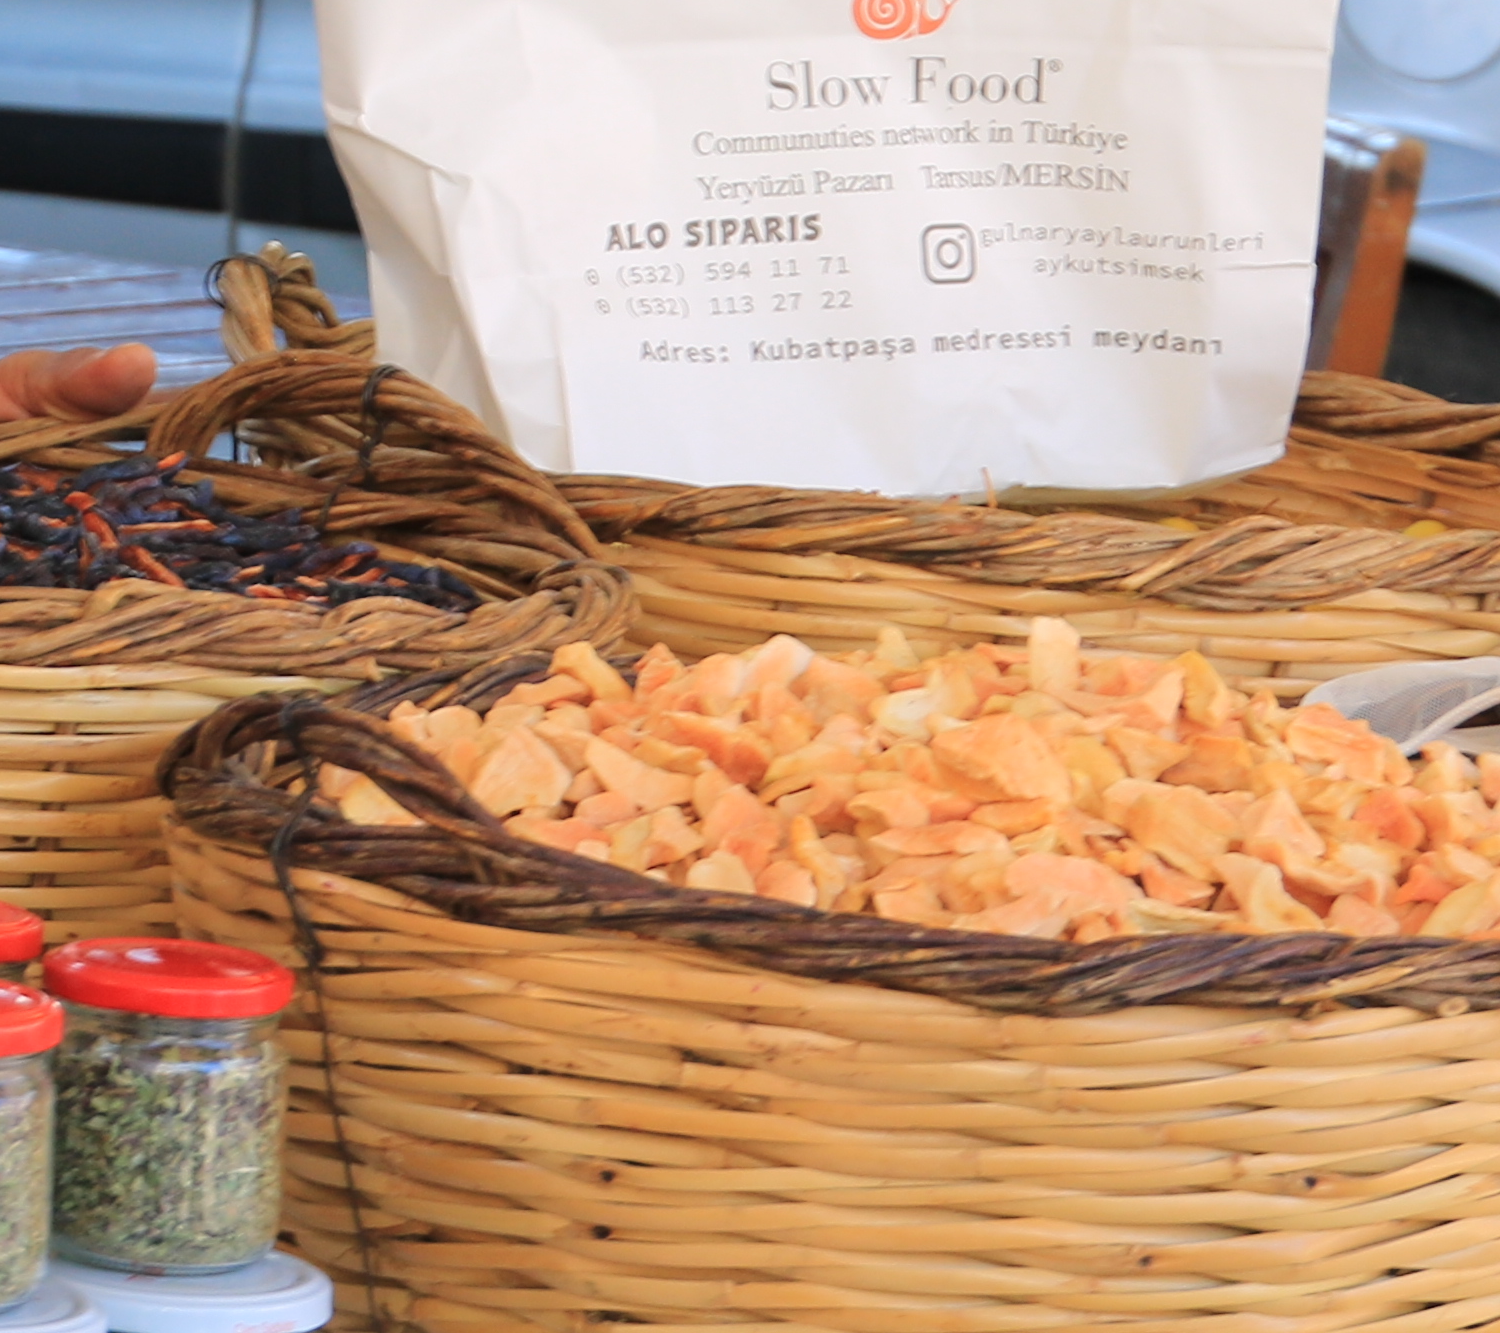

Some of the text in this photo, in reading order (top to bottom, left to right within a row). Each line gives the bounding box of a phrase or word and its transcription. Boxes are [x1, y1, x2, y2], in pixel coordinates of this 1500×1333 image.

[766, 58, 892, 111] Slow
[882, 119, 979, 148] network
[988, 119, 1013, 144] in
[1021, 120, 1129, 154] Türkiye
[697, 173, 806, 205] Yeryüzü
[813, 169, 894, 195] Pazarı
[605, 221, 670, 251] ALO
[704, 261, 752, 281] 594
[770, 258, 800, 278] 11
[818, 255, 851, 275] 71
[709, 295, 755, 316] 113
[771, 291, 802, 312] 27
[820, 290, 853, 310] 22
[640, 340, 730, 363] Adres:
[932, 325, 1072, 352] medresesi
